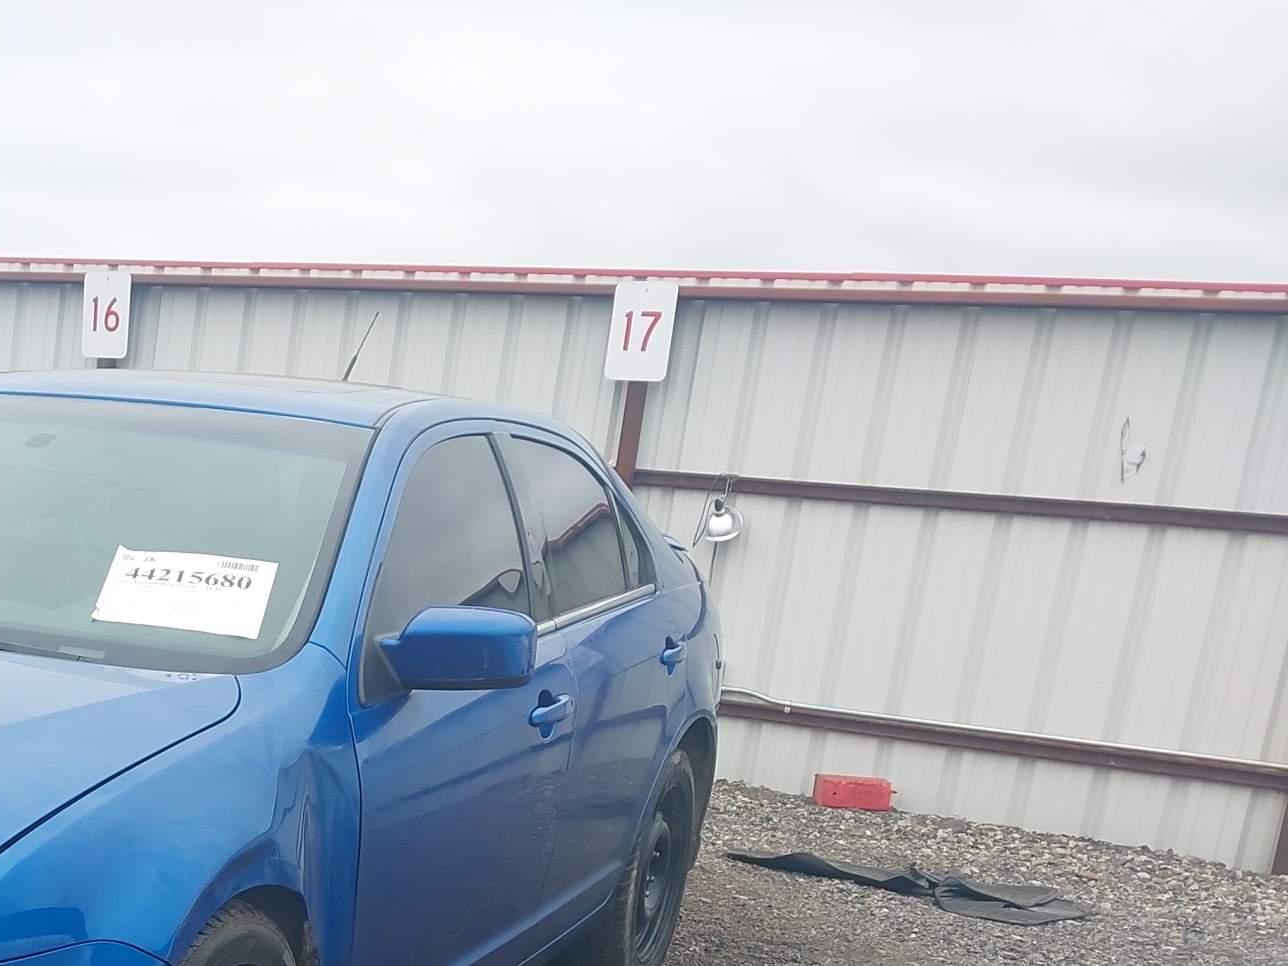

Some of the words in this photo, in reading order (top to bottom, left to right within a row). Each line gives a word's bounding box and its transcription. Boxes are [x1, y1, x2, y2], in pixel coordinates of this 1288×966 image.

[92, 296, 120, 333] 16
[622, 310, 663, 352] 17
[125, 566, 253, 590] 44215680
